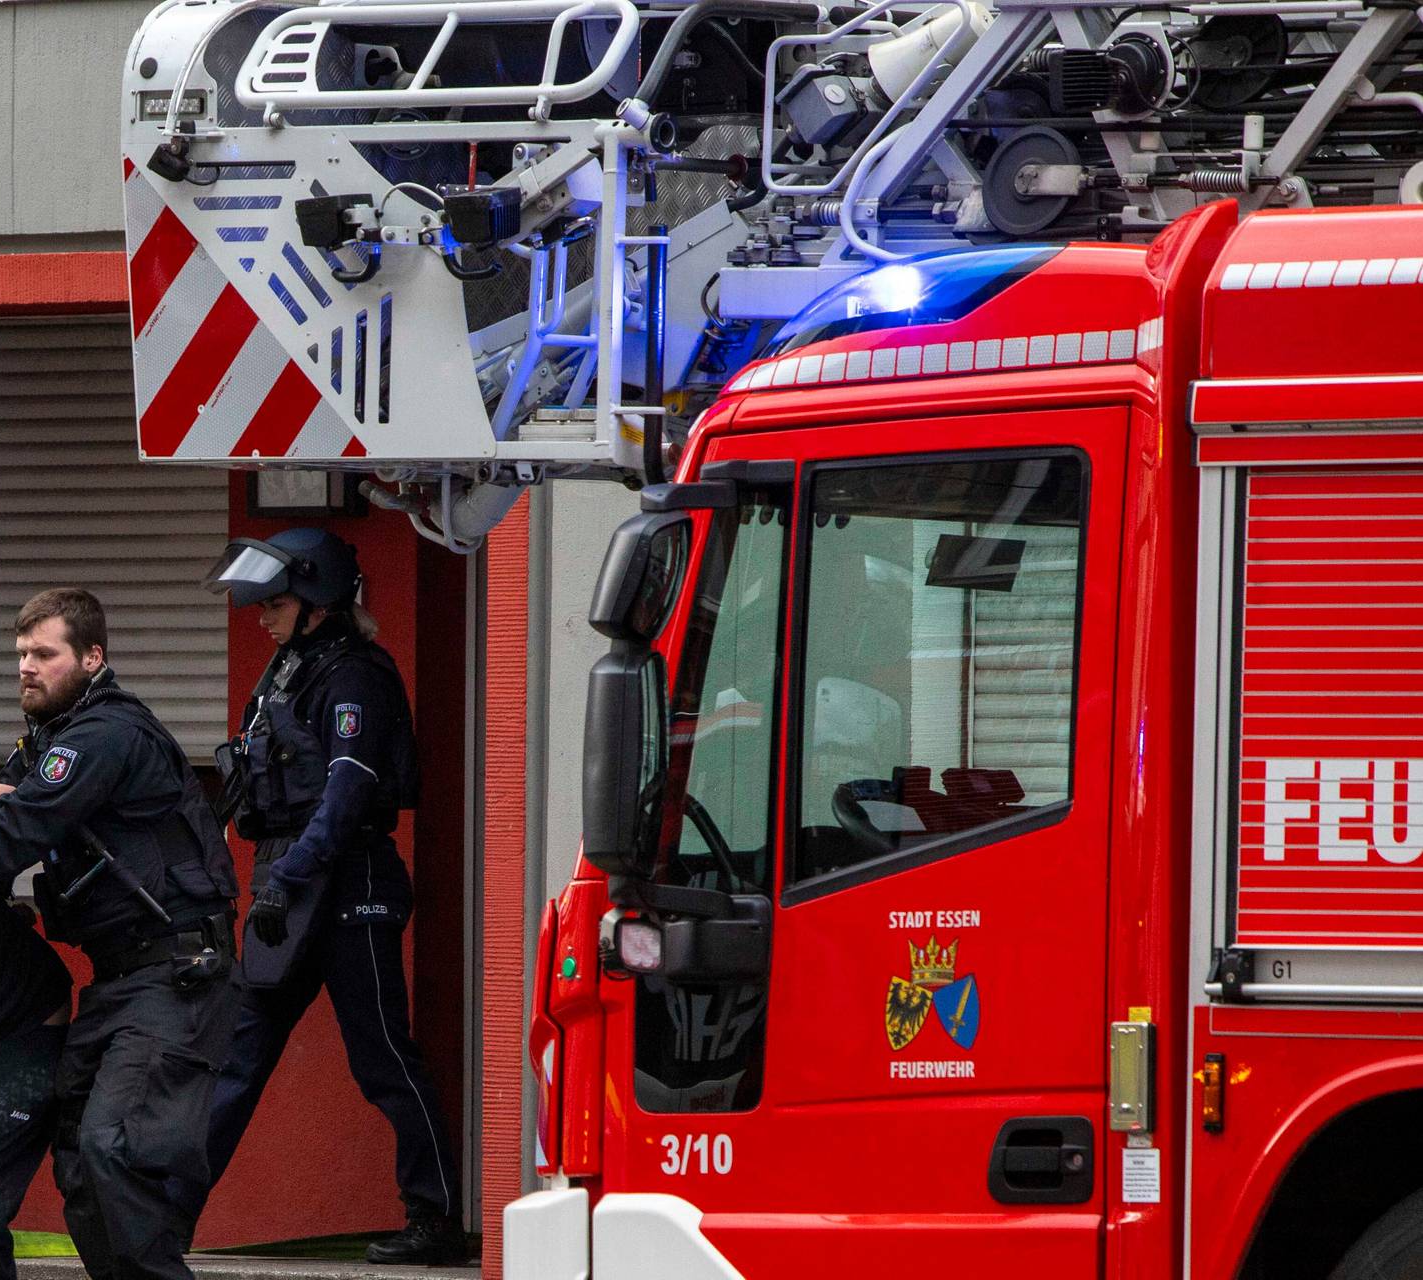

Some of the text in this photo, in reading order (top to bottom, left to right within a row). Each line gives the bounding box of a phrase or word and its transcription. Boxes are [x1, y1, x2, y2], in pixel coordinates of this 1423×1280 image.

[1263, 759, 1423, 864] FEU
[356, 904, 388, 916] POLIZEI
[888, 910, 981, 929] STADT ESSEN
[1272, 960, 1292, 979] G1
[890, 1061, 976, 1079] FEUERWEHR
[10, 1110, 30, 1121] JAKO
[660, 1133, 733, 1176] 3/10
